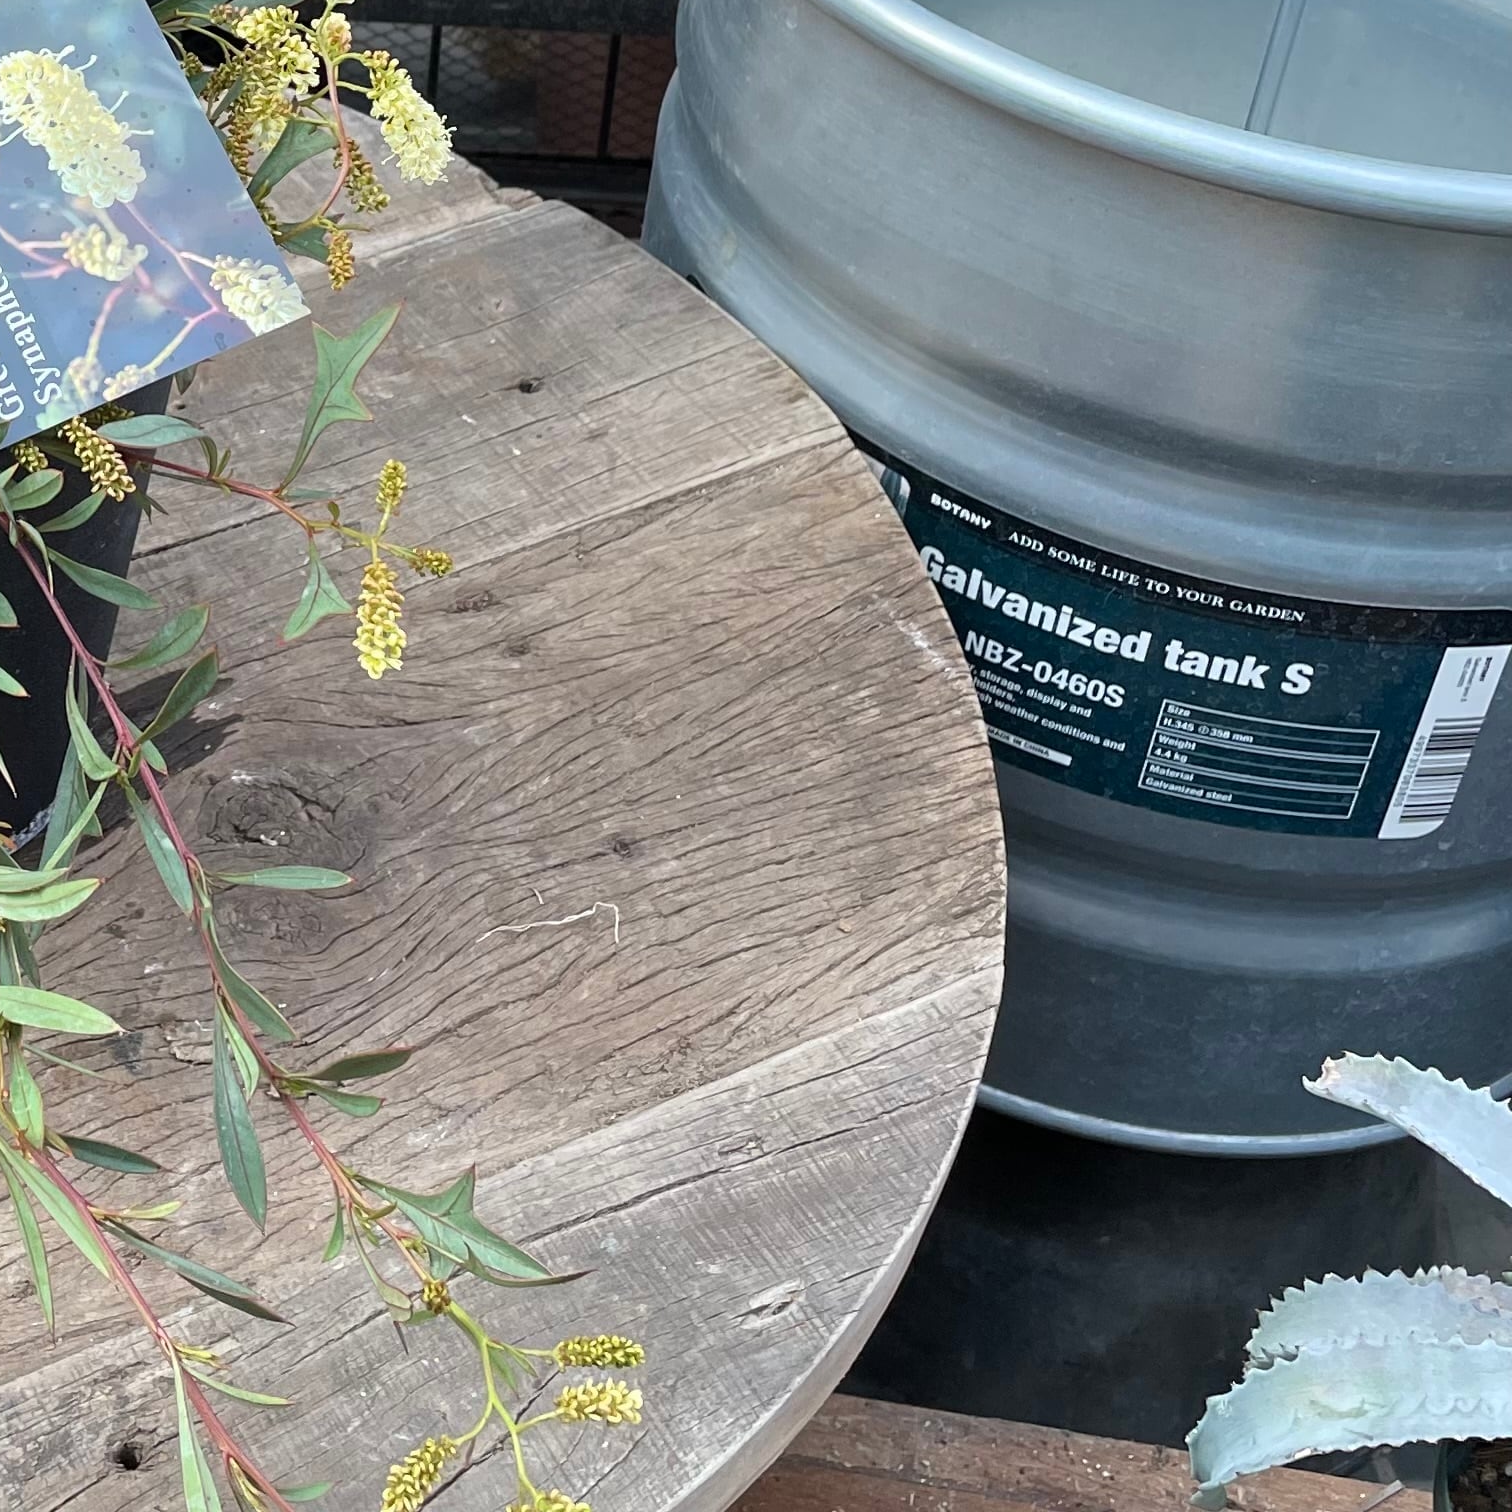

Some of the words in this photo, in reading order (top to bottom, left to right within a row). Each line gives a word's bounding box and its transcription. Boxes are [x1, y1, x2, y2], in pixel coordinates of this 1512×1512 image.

[930, 493, 992, 530] BOTANY
[1008, 531, 1044, 553] ADD
[1047, 546, 1097, 573] SOME
[1100, 564, 1140, 587] LIFE
[1144, 578, 1170, 596] TO
[1176, 586, 1224, 609] YOUR
[1229, 600, 1306, 623] GARDEN
[919, 545, 1153, 664] Galvanized
[1164, 638, 1271, 689] tank
[1280, 662, 1315, 695] S
[964, 630, 1126, 708] NBZ-0460S
[1026, 688, 1068, 712] display
[1069, 703, 1093, 718] and
[1167, 704, 1191, 717] Size
[994, 699, 1040, 724] weather
[1041, 718, 1101, 745] conditions
[1102, 738, 1126, 752] and
[1232, 732, 1254, 744] mm
[1158, 734, 1197, 751] Weight
[1173, 751, 1188, 764] kg
[1149, 764, 1195, 782] Material
[1145, 777, 1205, 798] Galvanized
[1205, 791, 1233, 803] steel
